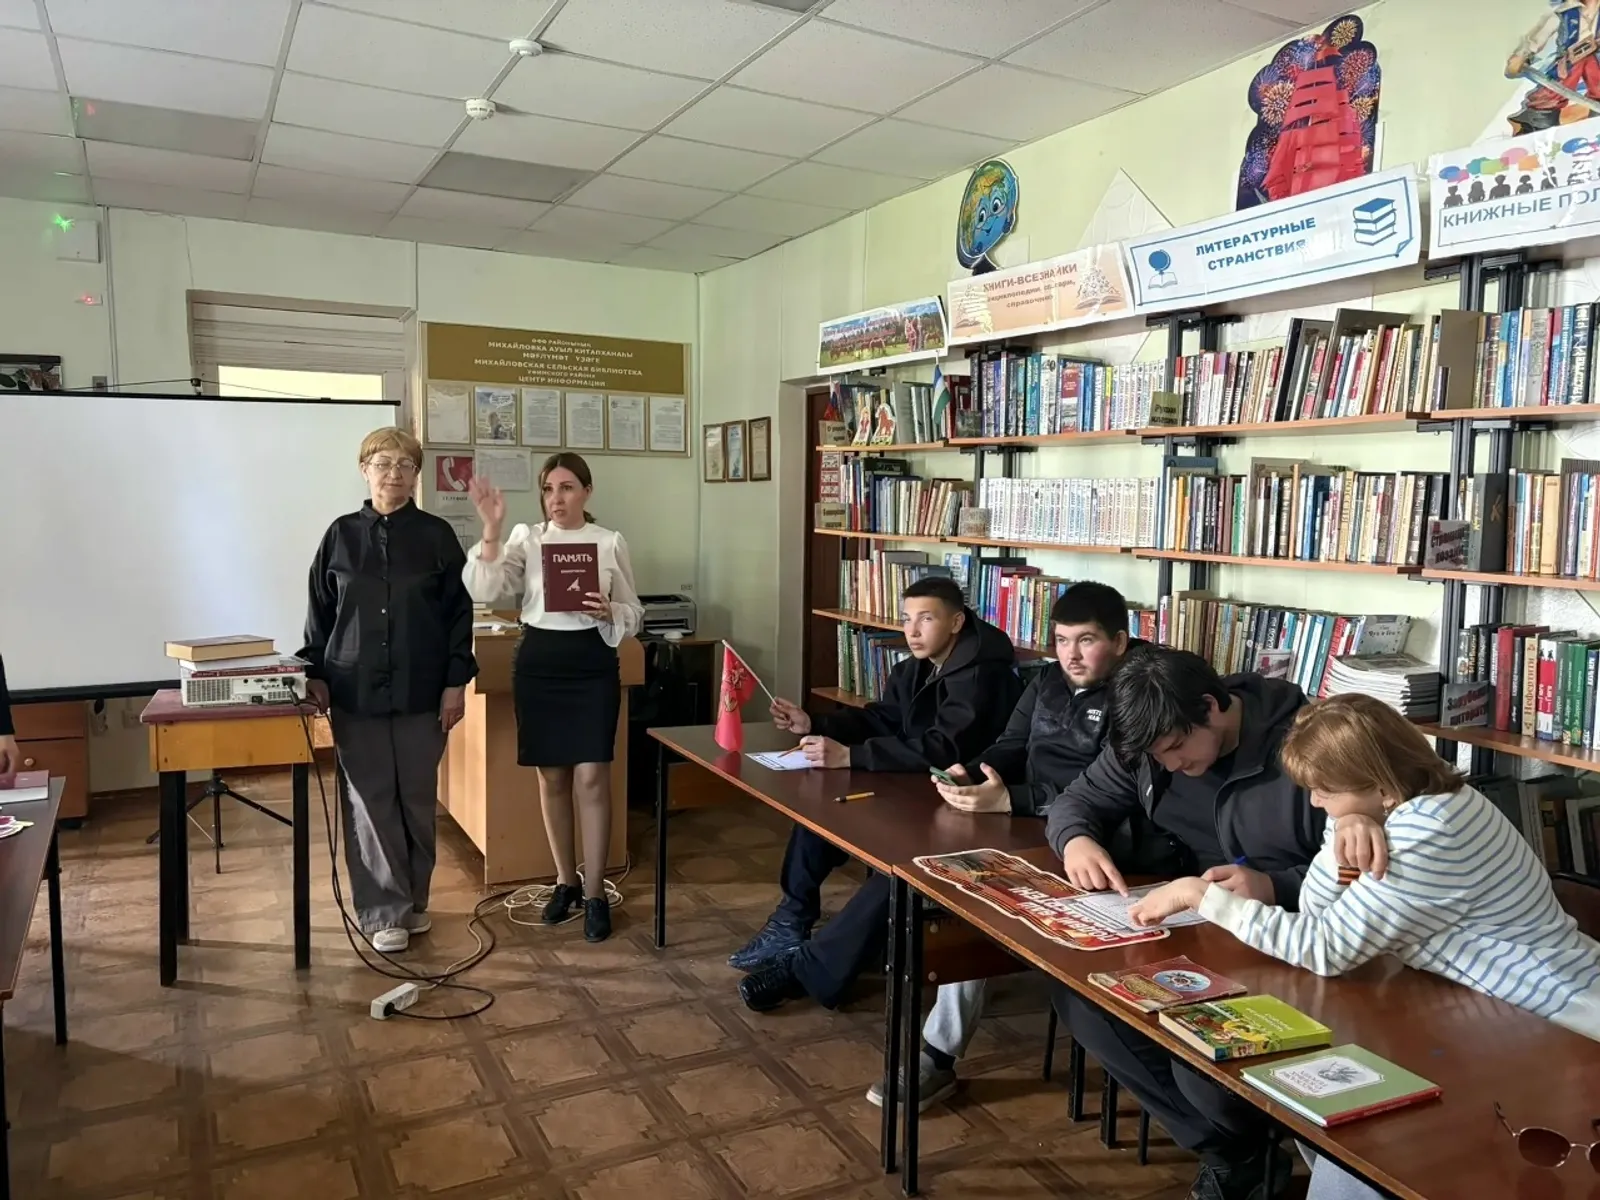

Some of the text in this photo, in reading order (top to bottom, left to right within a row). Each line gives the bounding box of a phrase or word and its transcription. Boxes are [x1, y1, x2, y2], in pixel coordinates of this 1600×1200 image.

[1443, 197, 1552, 229] КНИЖНЫЕ
[1195, 217, 1316, 256] ЛИТЕРАТУРНЫЕ
[488, 341, 547, 352] МИХАЙЛОВКА
[549, 345, 573, 354] АУЫЛ
[474, 358, 643, 377] МИХАЙЛОВСКАЯ СЕЛЬСКАЯ БИБЛИОТЕКА
[518, 375, 606, 388] ЦЕНТР ИНФОРМАЦИИ
[552, 553, 593, 563] ПАМЯТЬ
[1524, 658, 1535, 715] Нефертити
